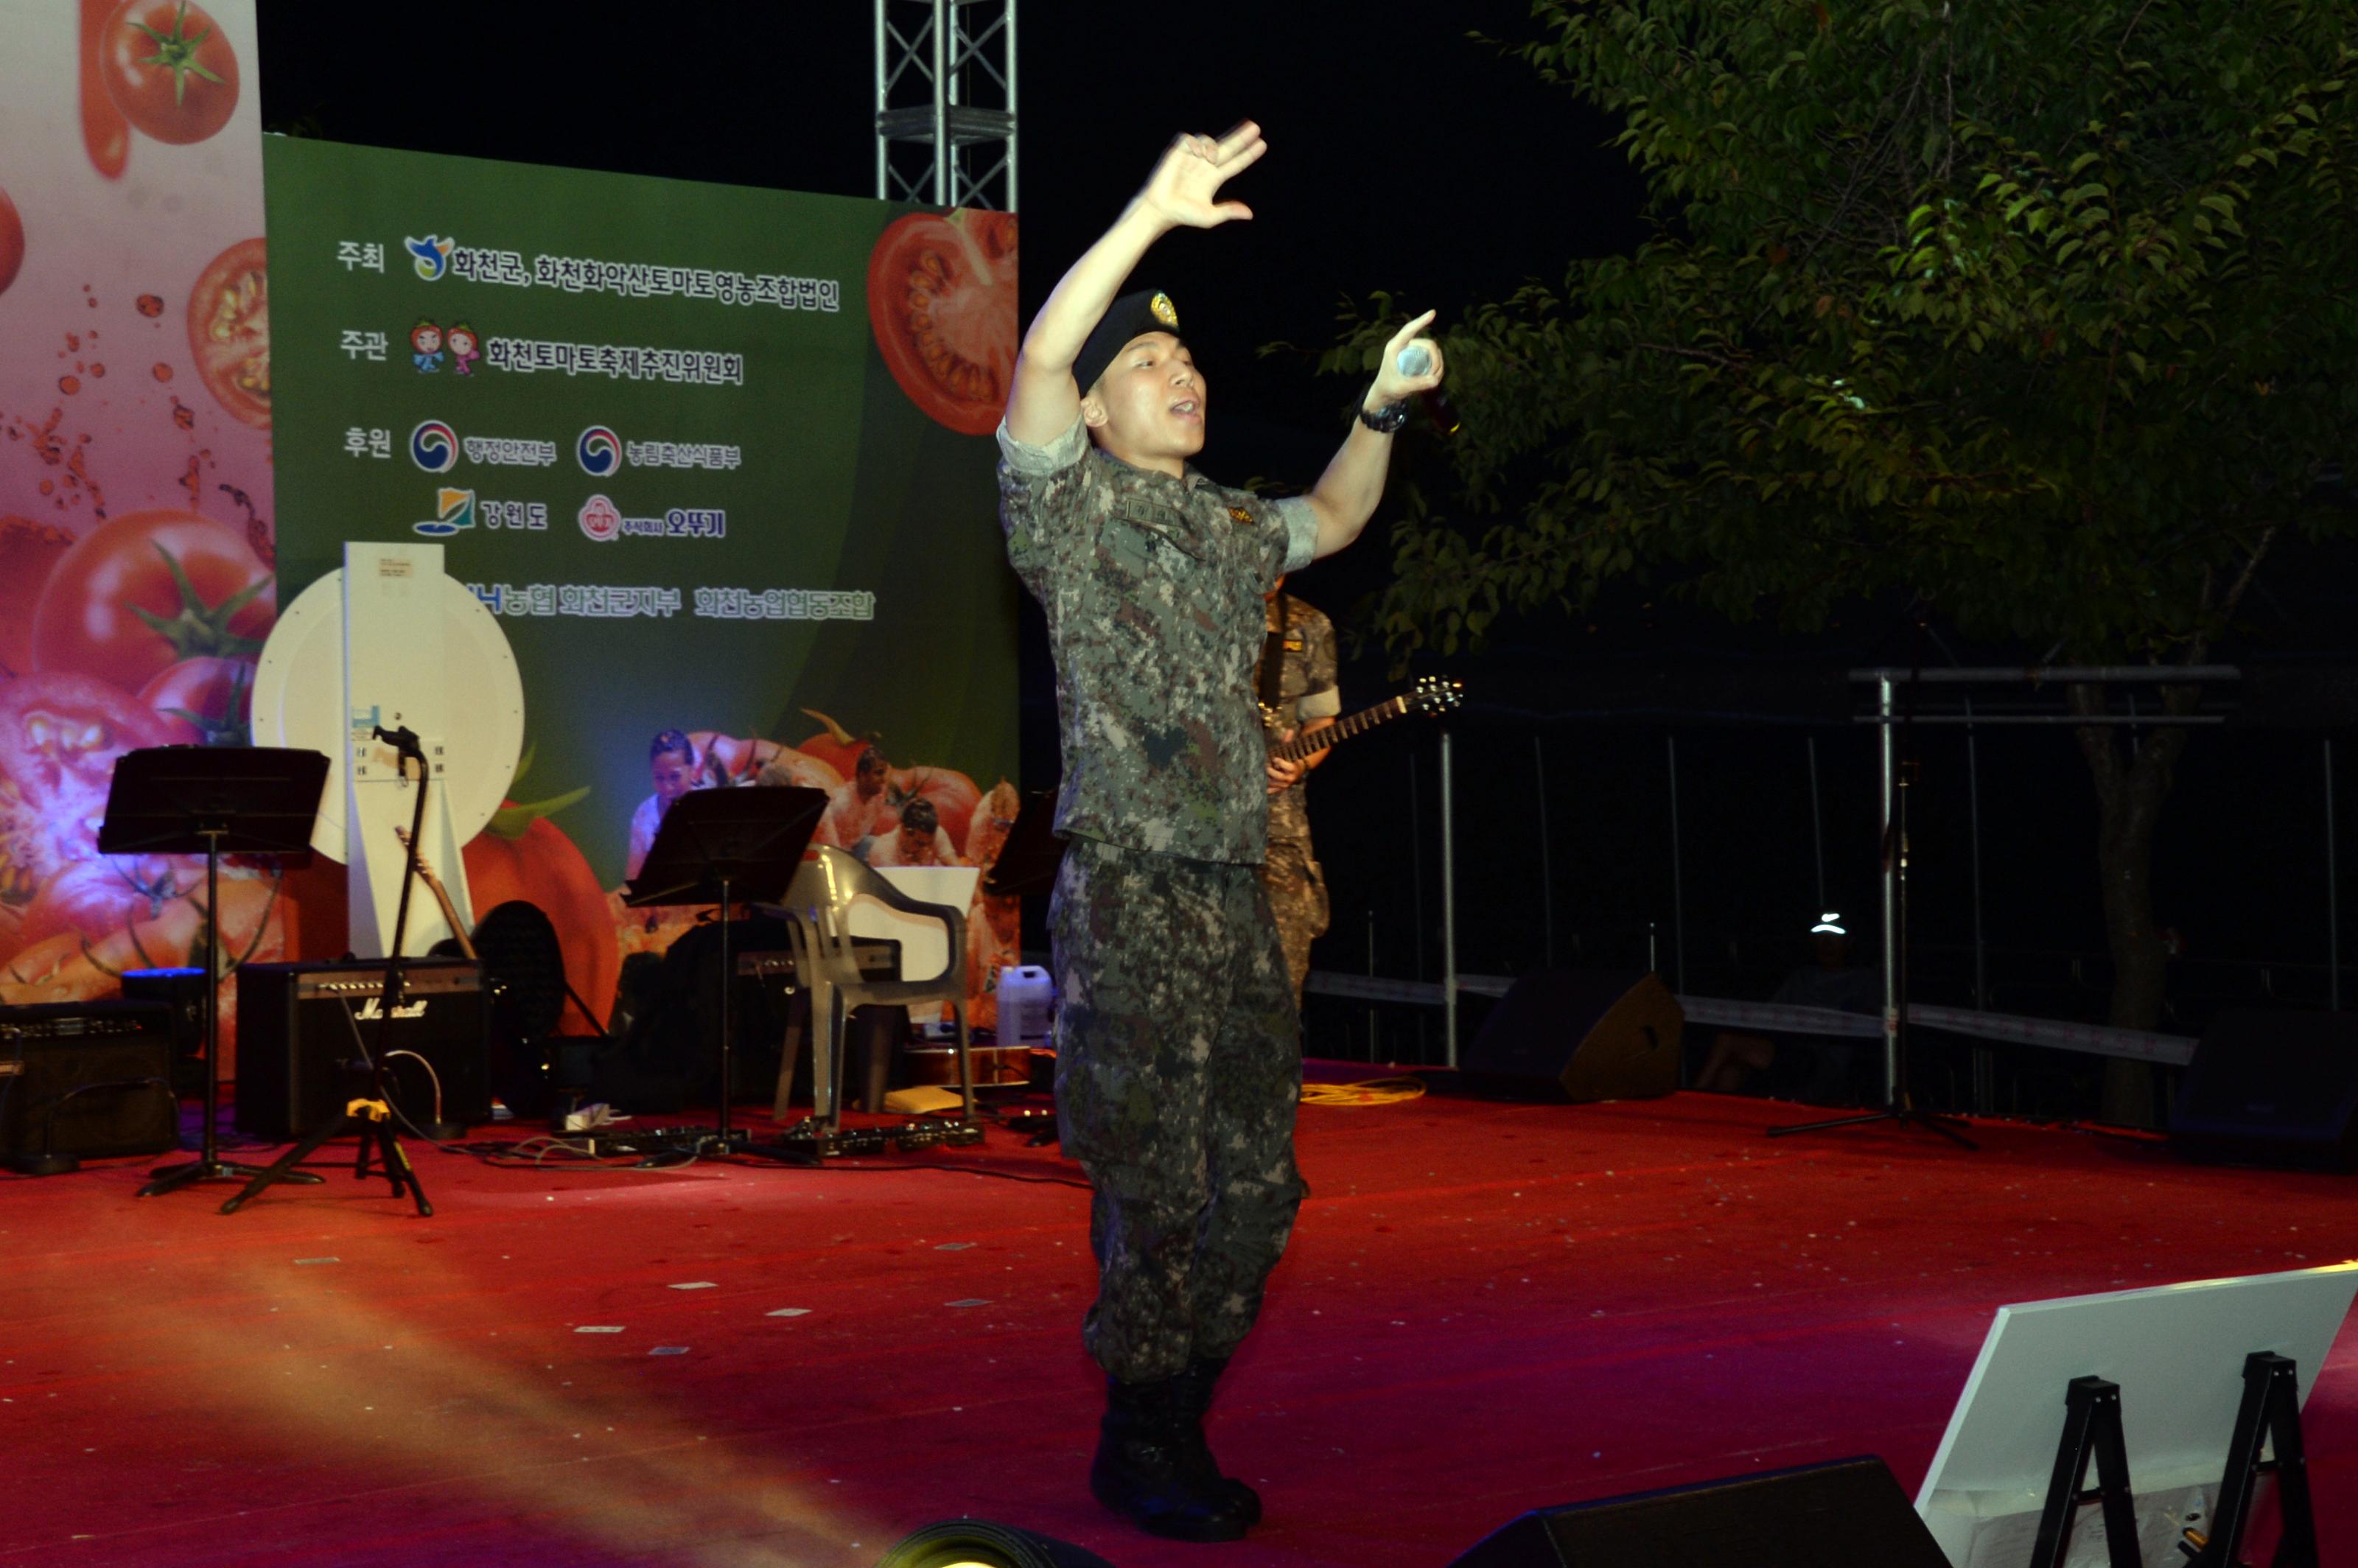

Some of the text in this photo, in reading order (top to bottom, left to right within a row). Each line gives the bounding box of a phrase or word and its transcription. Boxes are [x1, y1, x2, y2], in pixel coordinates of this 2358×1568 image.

[337, 241, 385, 273] 주최
[453, 248, 839, 311] 화천군, 화천화악산토마토영농조합법인
[340, 329, 388, 361] 주관
[488, 338, 742, 384] 화천토마토축제추진위원회
[344, 427, 391, 458] 후원
[464, 438, 556, 466] 행정안전부
[628, 442, 741, 469] 농림축산식품부
[481, 501, 547, 528] 강원도
[668, 510, 724, 536] 오뚜기
